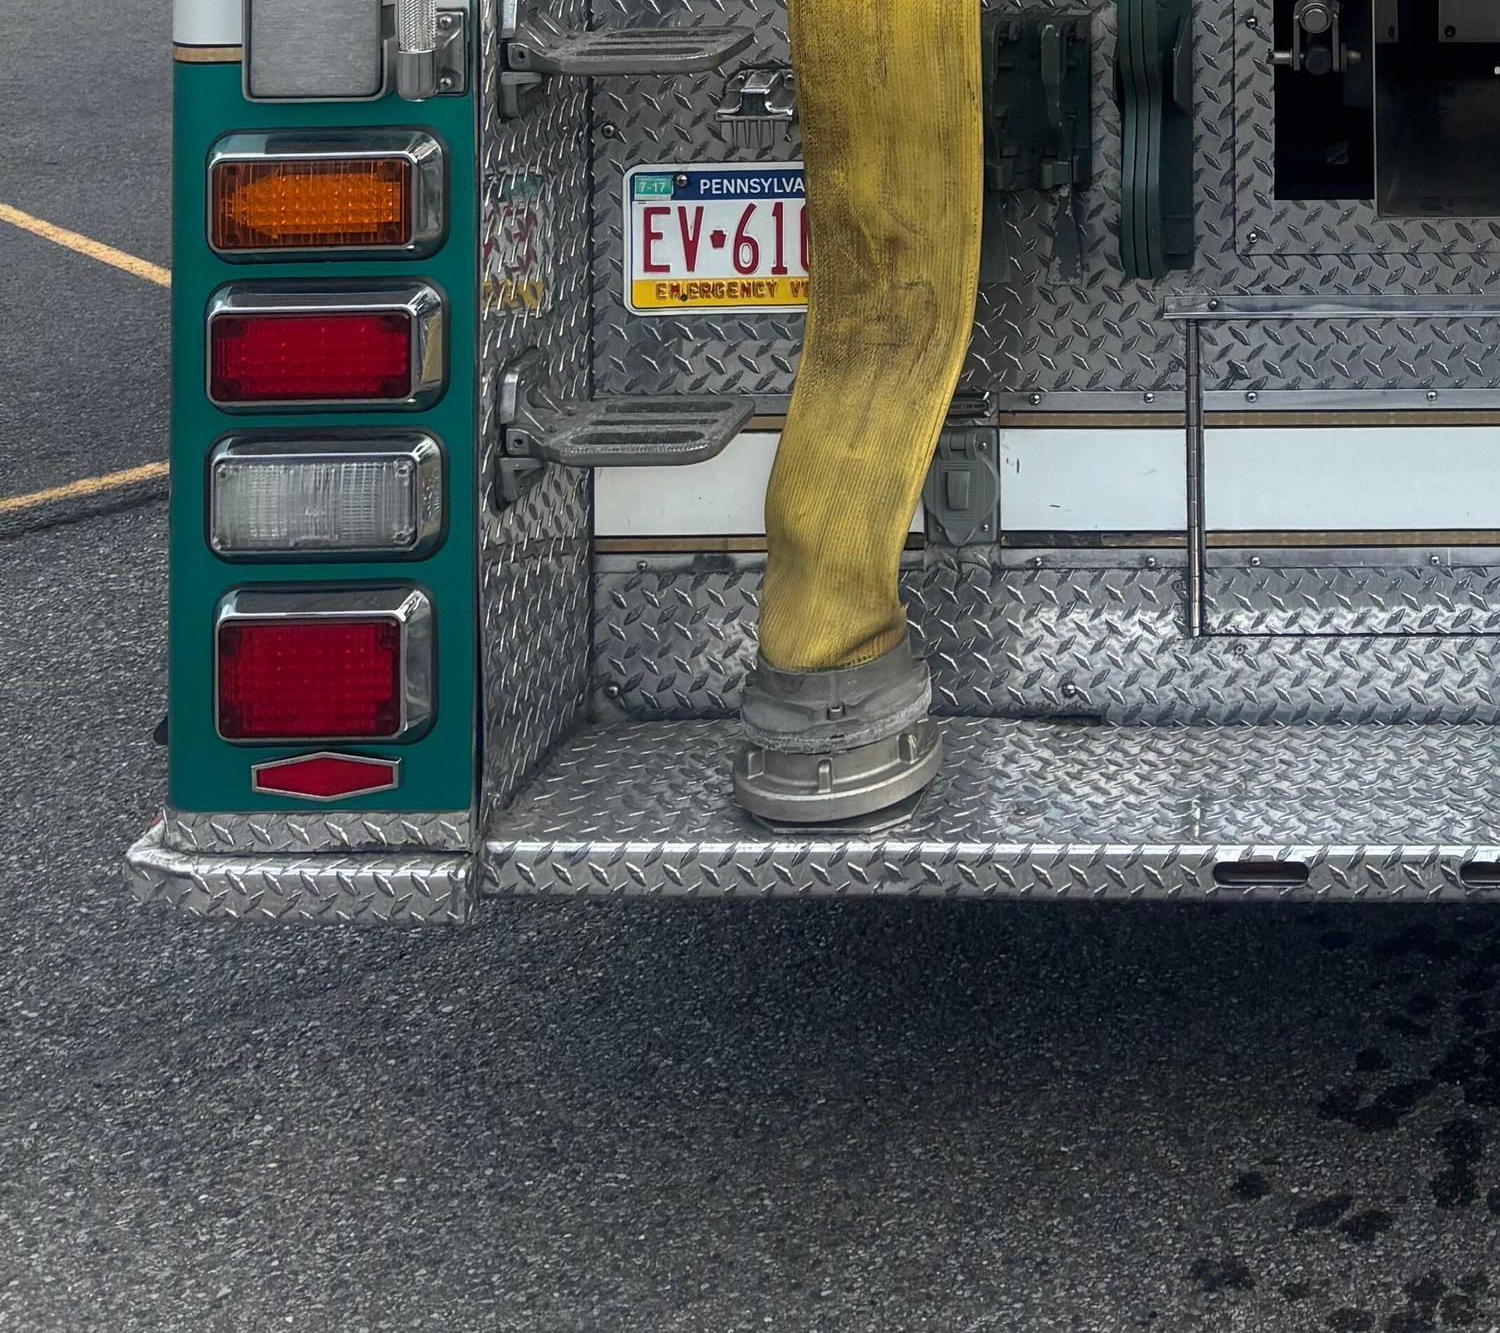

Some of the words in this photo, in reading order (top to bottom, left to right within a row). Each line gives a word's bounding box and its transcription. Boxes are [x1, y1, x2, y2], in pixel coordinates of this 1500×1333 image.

[638, 182, 665, 192] 7-17
[700, 178, 804, 195] PENNSYLVA
[656, 280, 778, 300] EMERGENCY
